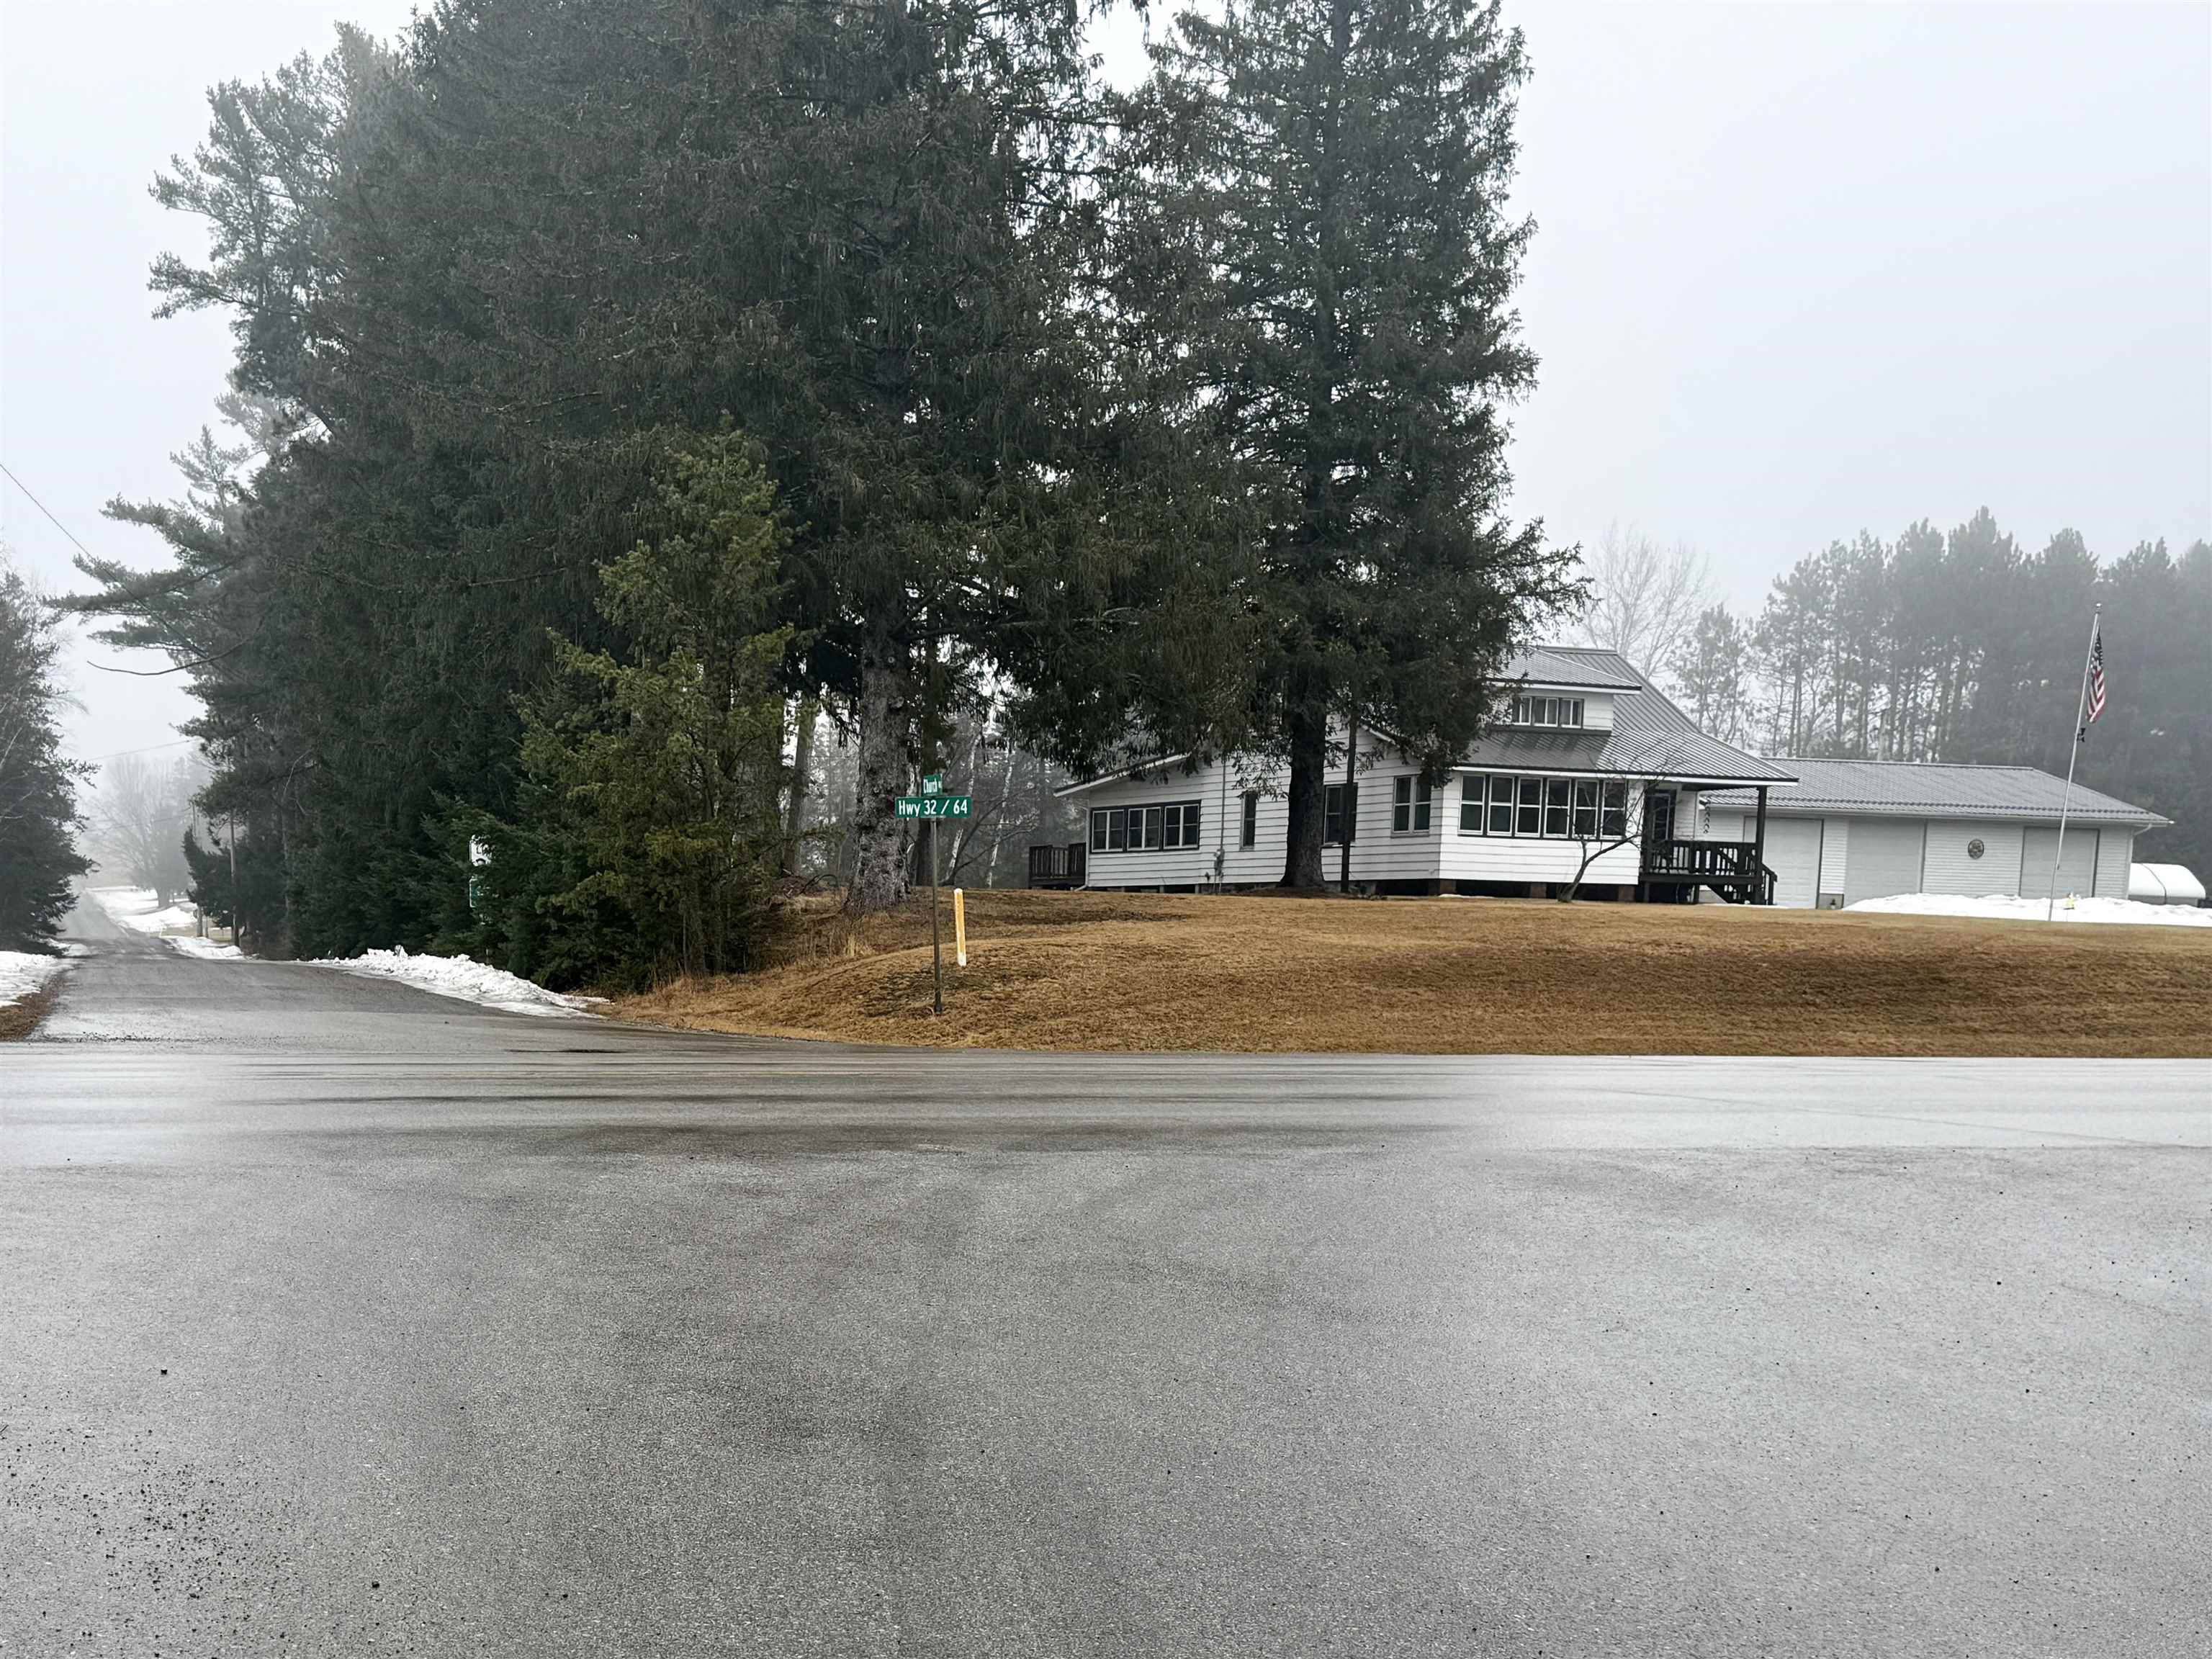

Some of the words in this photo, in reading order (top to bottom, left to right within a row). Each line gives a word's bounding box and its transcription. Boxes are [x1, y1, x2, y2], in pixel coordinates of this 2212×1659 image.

[899, 800, 920, 817] Hwy
[924, 799, 937, 814] 32
[953, 799, 968, 814] 64
